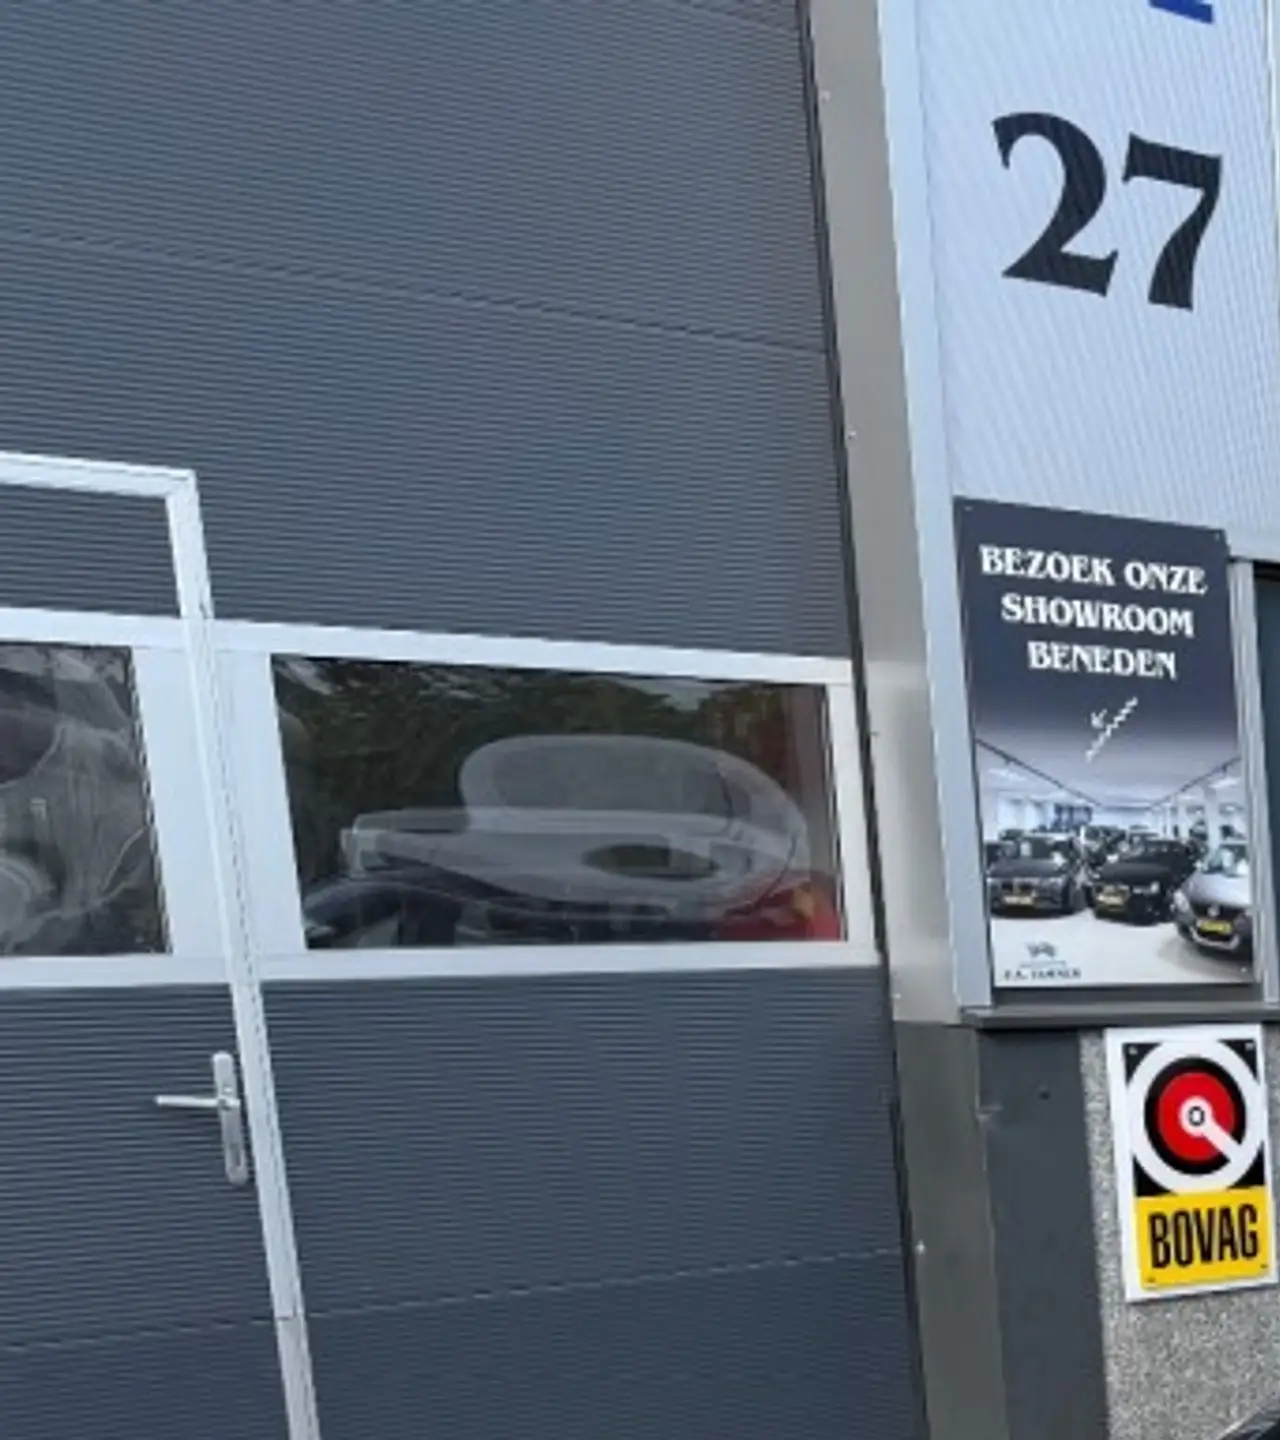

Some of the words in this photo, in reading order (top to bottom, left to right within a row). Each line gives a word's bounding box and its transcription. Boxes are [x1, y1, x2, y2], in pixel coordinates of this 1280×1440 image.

[992, 111, 1222, 310] 27
[979, 543, 1116, 587] BEZOEK
[1124, 560, 1209, 596] ONZE
[1001, 592, 1195, 639] SHOWROOM
[1027, 640, 1177, 682] BENEDEN
[1148, 1203, 1259, 1270] BOVAG
